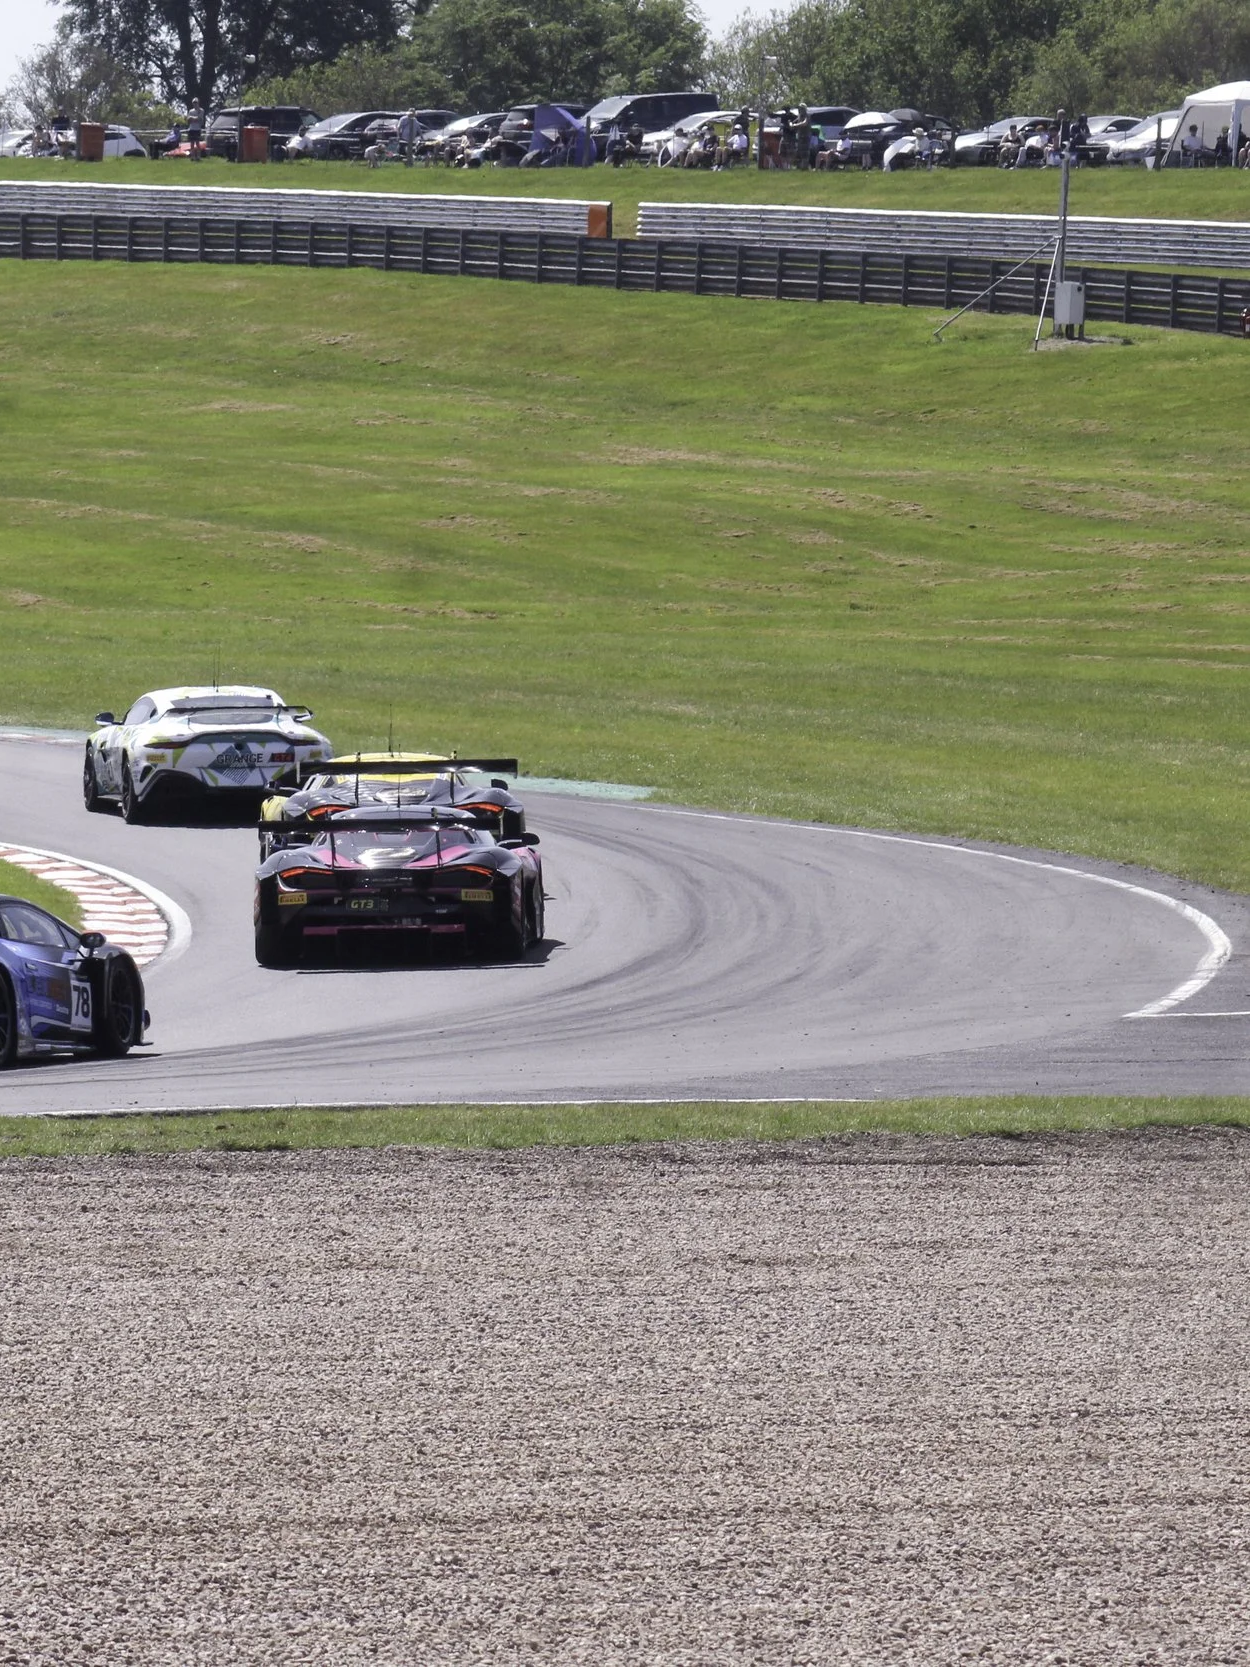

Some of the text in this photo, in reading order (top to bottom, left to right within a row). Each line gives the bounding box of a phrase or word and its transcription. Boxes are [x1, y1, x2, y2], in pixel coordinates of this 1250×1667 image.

[216, 753, 263, 764] GRANGE
[351, 900, 374, 909] GT3
[72, 984, 90, 1018] 78
